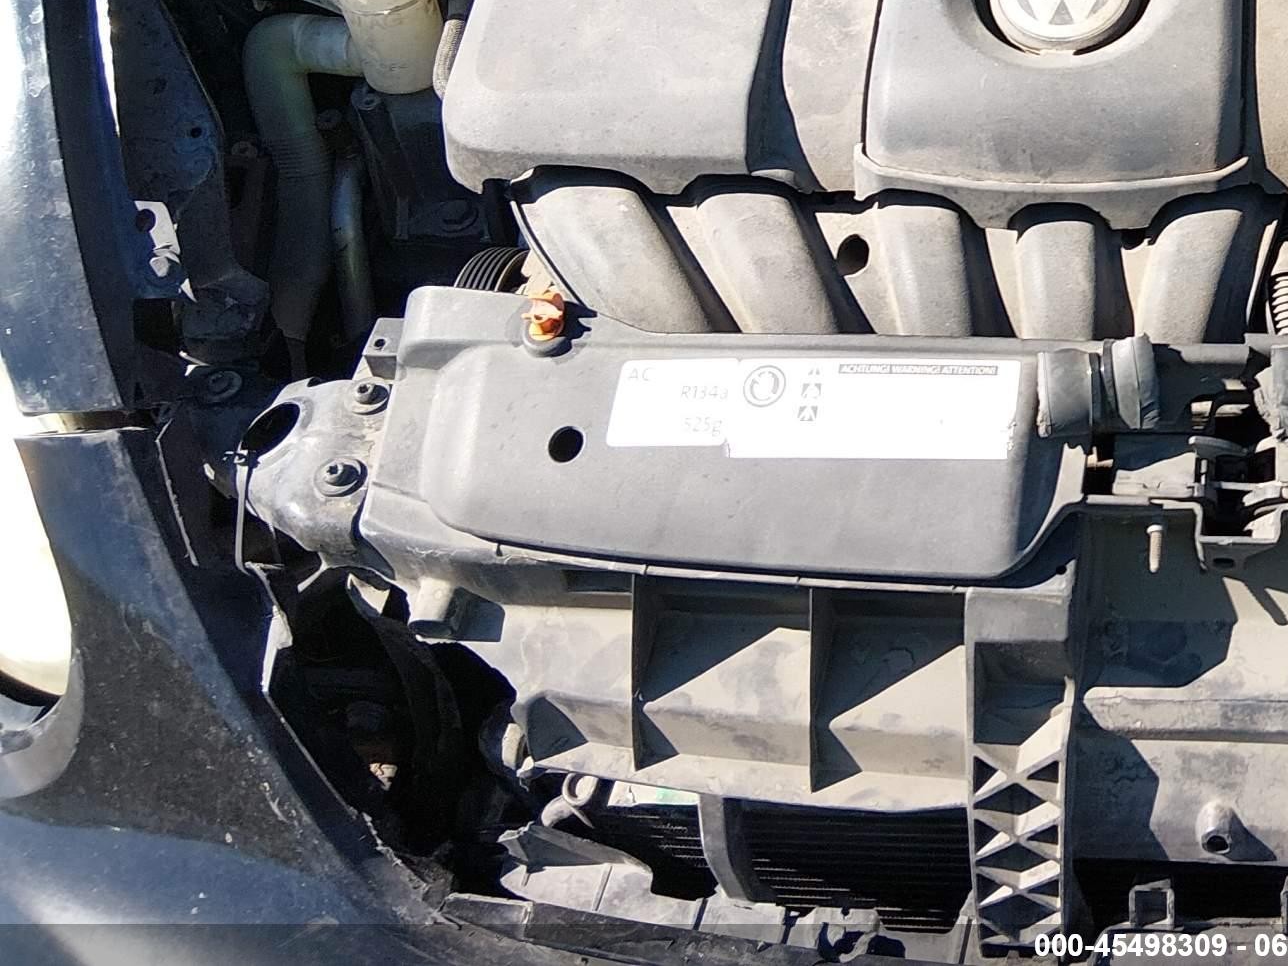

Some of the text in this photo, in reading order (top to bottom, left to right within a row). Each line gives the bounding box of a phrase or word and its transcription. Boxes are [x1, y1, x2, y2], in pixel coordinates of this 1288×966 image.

[840, 364, 996, 375] ACHTUNG! WARNING! ATTENTION!
[680, 385, 728, 400] R134a
